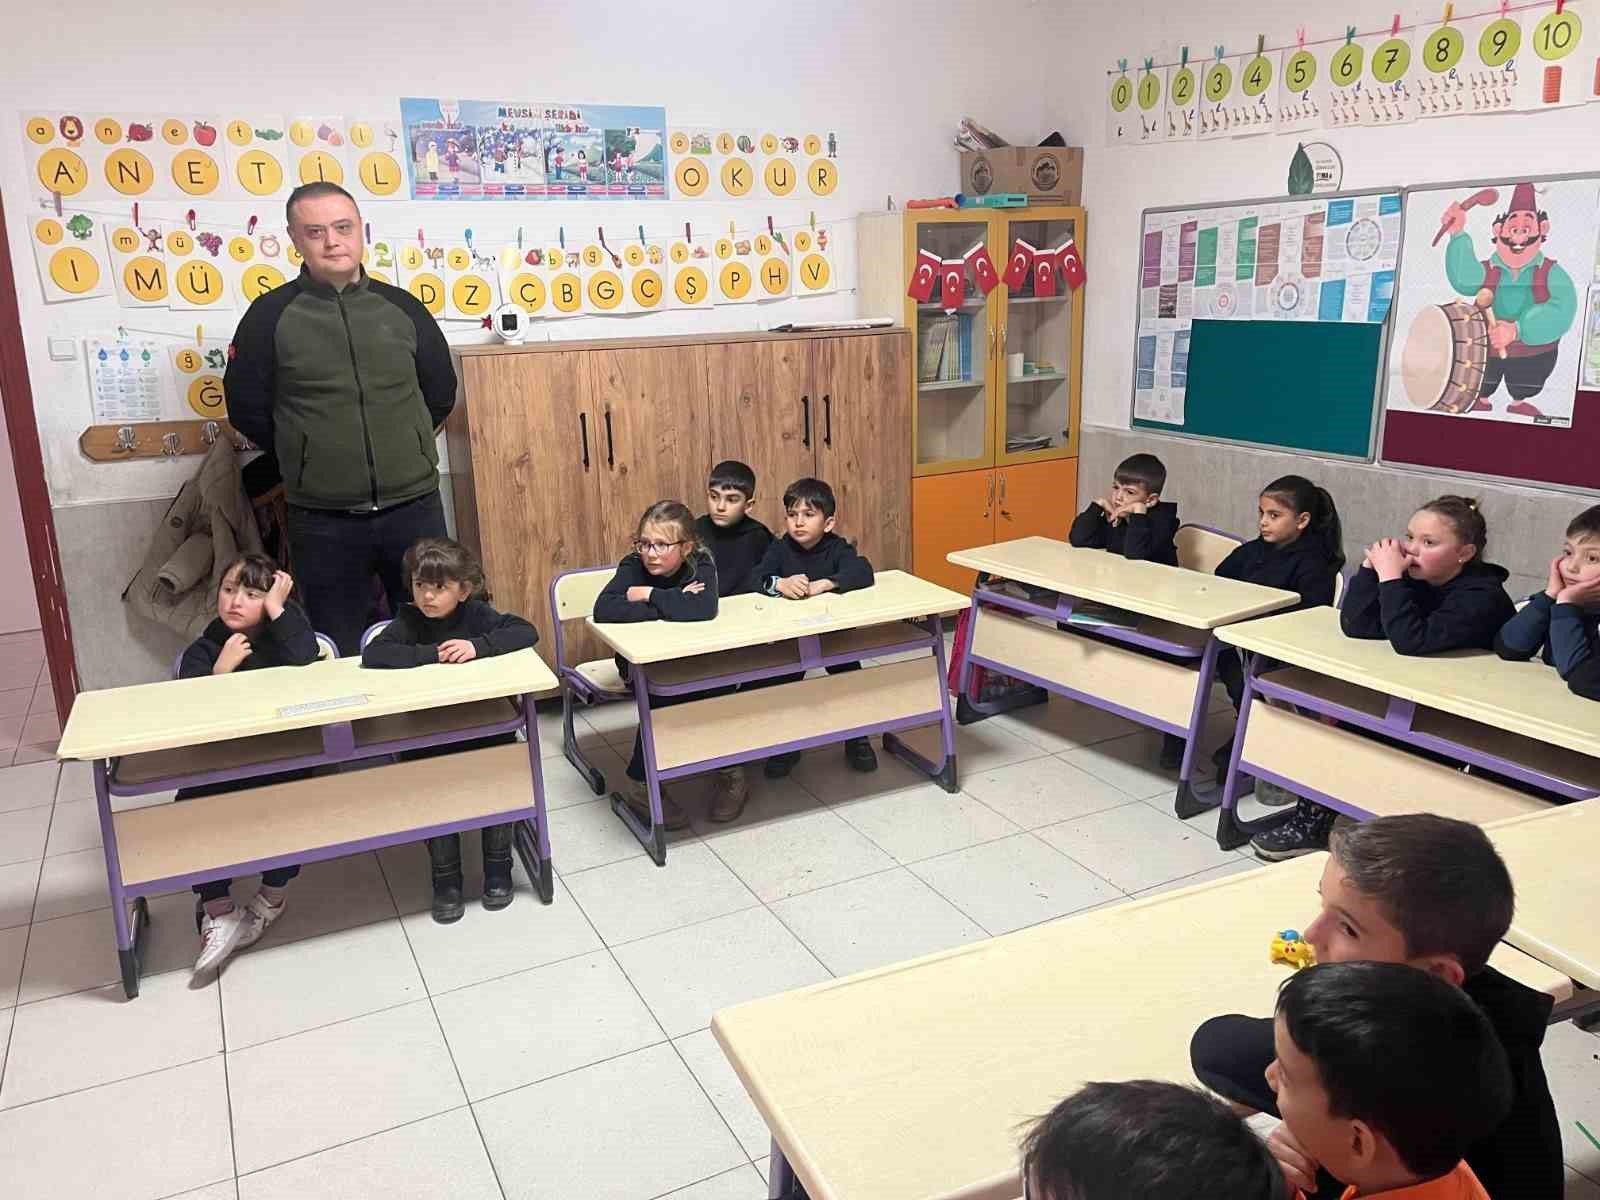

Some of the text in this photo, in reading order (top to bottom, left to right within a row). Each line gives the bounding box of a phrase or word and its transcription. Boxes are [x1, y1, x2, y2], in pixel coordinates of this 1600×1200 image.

[1117, 84, 1127, 104] 0
[1177, 76, 1188, 98] 2
[1213, 72, 1223, 93] 3
[1250, 65, 1262, 87] 4
[1294, 60, 1306, 83] 5
[1340, 53, 1353, 77] 6
[1385, 48, 1399, 73] 7
[1435, 37, 1450, 62] 8
[1493, 30, 1507, 56] 9
[1543, 21, 1571, 50] 10
[36, 127, 45, 135] a
[104, 127, 112, 136] n
[171, 128, 178, 136] e
[236, 125, 243, 137] t
[54, 160, 75, 184] A
[118, 160, 140, 184] N
[187, 161, 204, 184] E
[250, 162, 266, 185] T
[373, 160, 389, 185] L
[683, 167, 827, 187] O K U R
[120, 236, 132, 245] m
[176, 237, 184, 248] ü
[409, 250, 415, 265] d
[549, 253, 556, 265] b
[589, 251, 596, 263] g
[720, 244, 726, 256] p
[759, 239, 766, 251] h
[134, 268, 162, 291] M
[189, 265, 210, 294] Ü
[420, 263, 820, 307] D Z Ç B G C Ş P H V
[184, 352, 193, 368] ğ
[200, 379, 223, 408] Ğ
